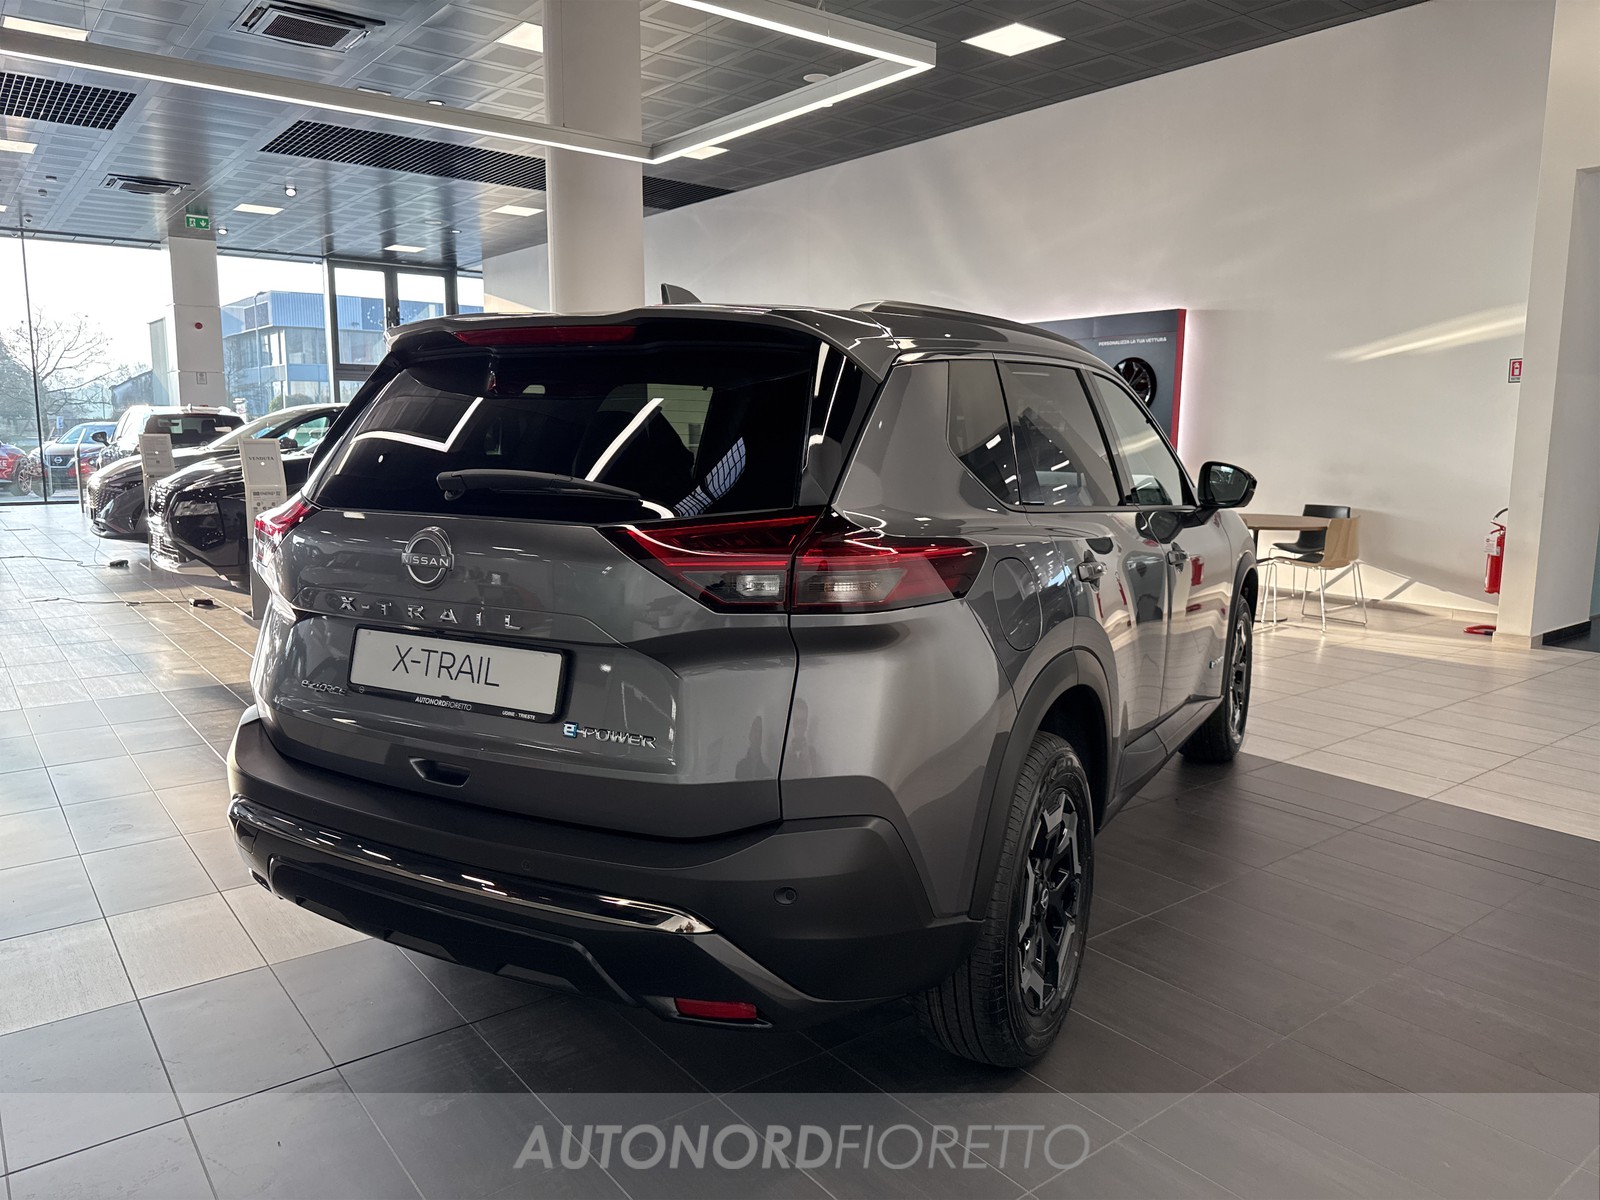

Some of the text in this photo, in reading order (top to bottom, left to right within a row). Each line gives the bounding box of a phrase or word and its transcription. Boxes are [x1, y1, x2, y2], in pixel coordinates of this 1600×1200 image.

[402, 553, 449, 567] NISSAN
[338, 595, 523, 631] X-TRAIL
[392, 645, 499, 687] X-TRAIL
[415, 696, 472, 711] AUTONORDFIORETTO
